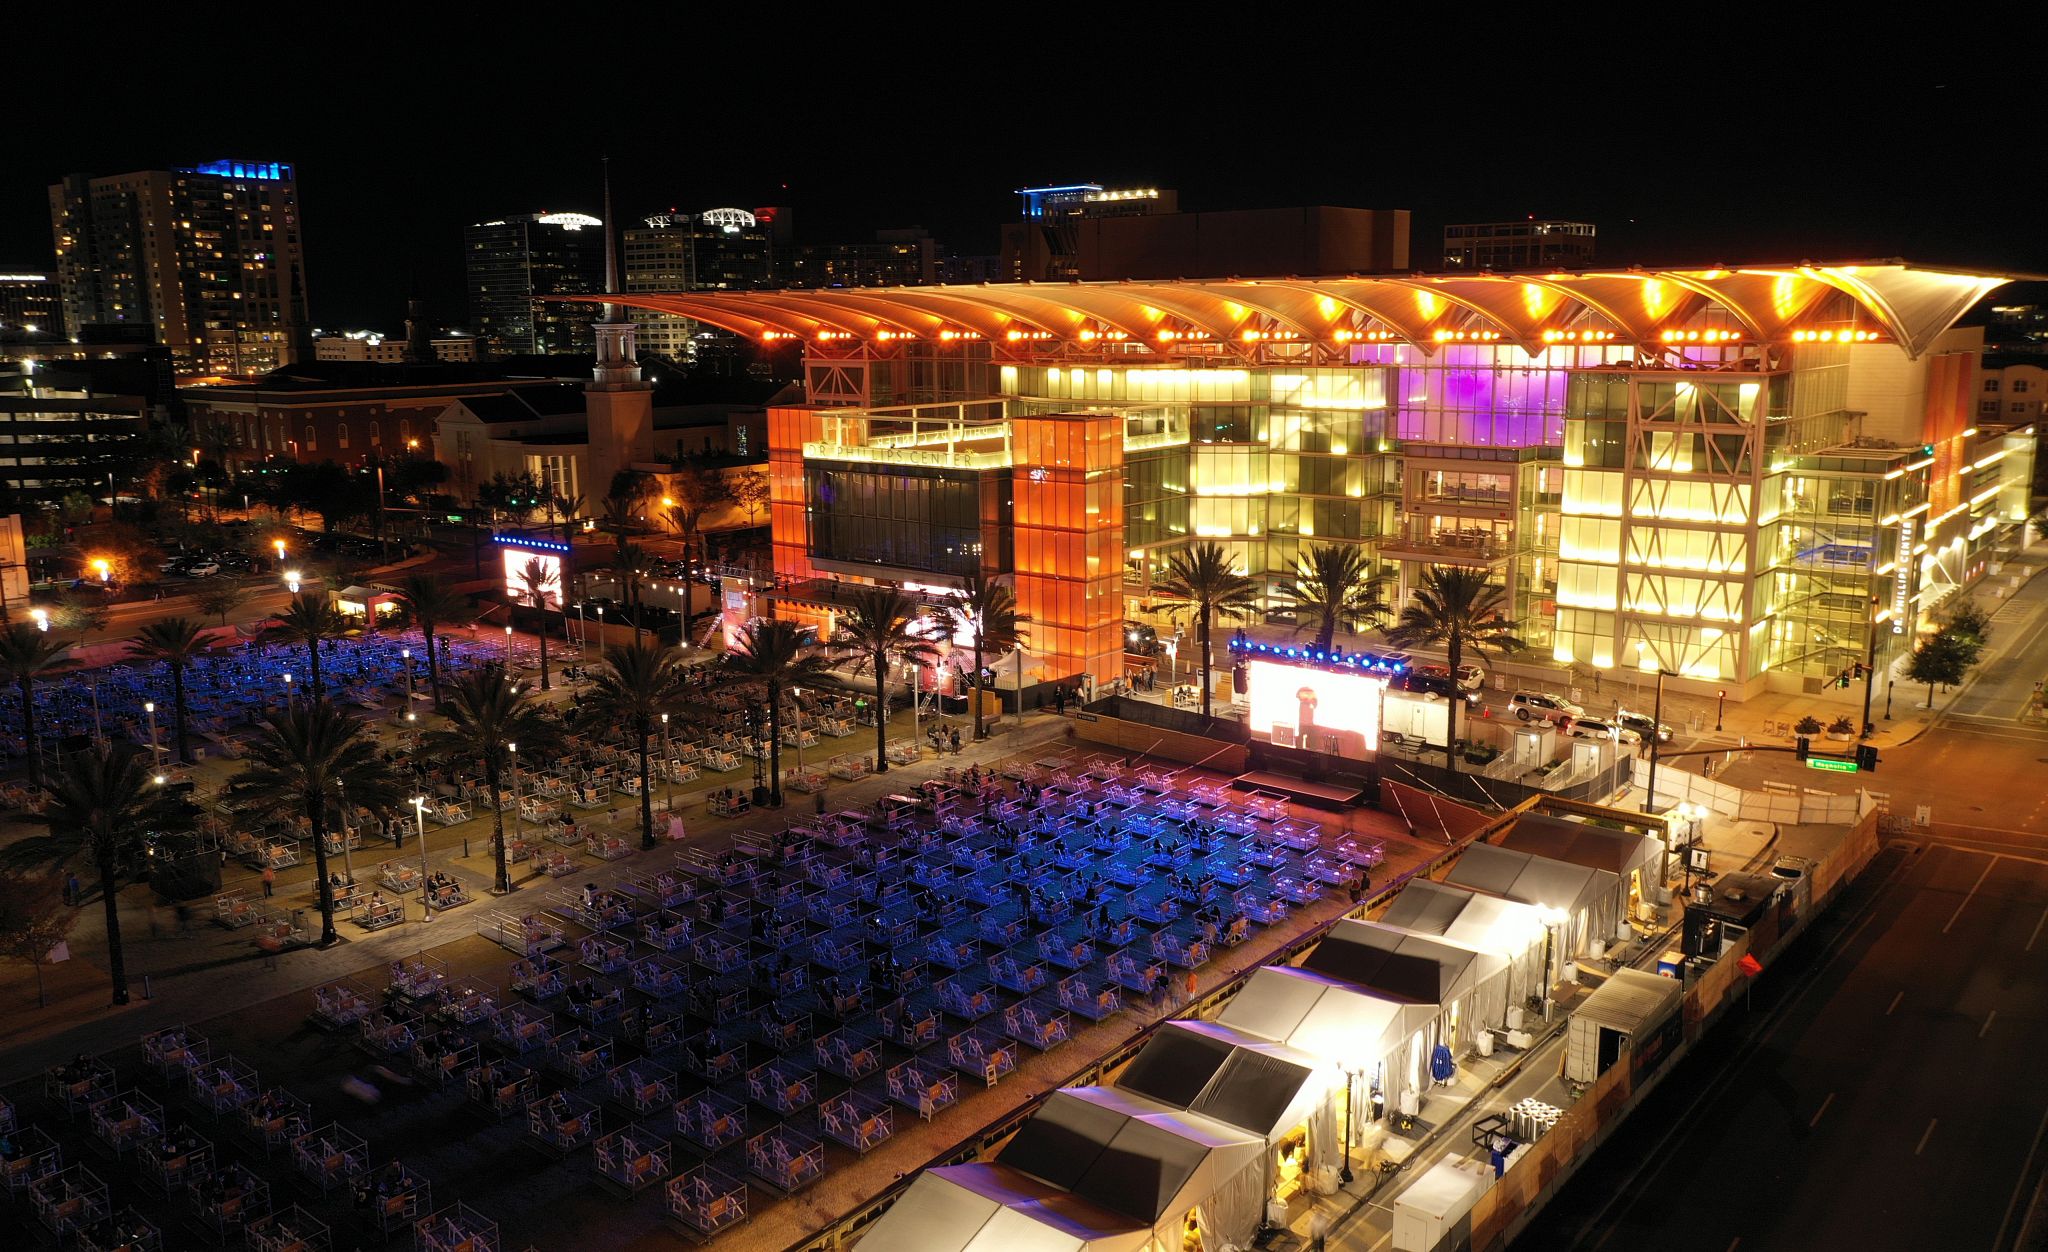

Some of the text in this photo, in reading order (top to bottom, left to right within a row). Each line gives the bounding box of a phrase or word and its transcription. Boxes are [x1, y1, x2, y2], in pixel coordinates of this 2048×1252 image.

[837, 446, 903, 463] PHILLIPS
[910, 450, 972, 467] CENTER
[1893, 522, 1912, 634] DR. PHILLIPS CENTER
[1815, 761, 1847, 770] Magnolia
